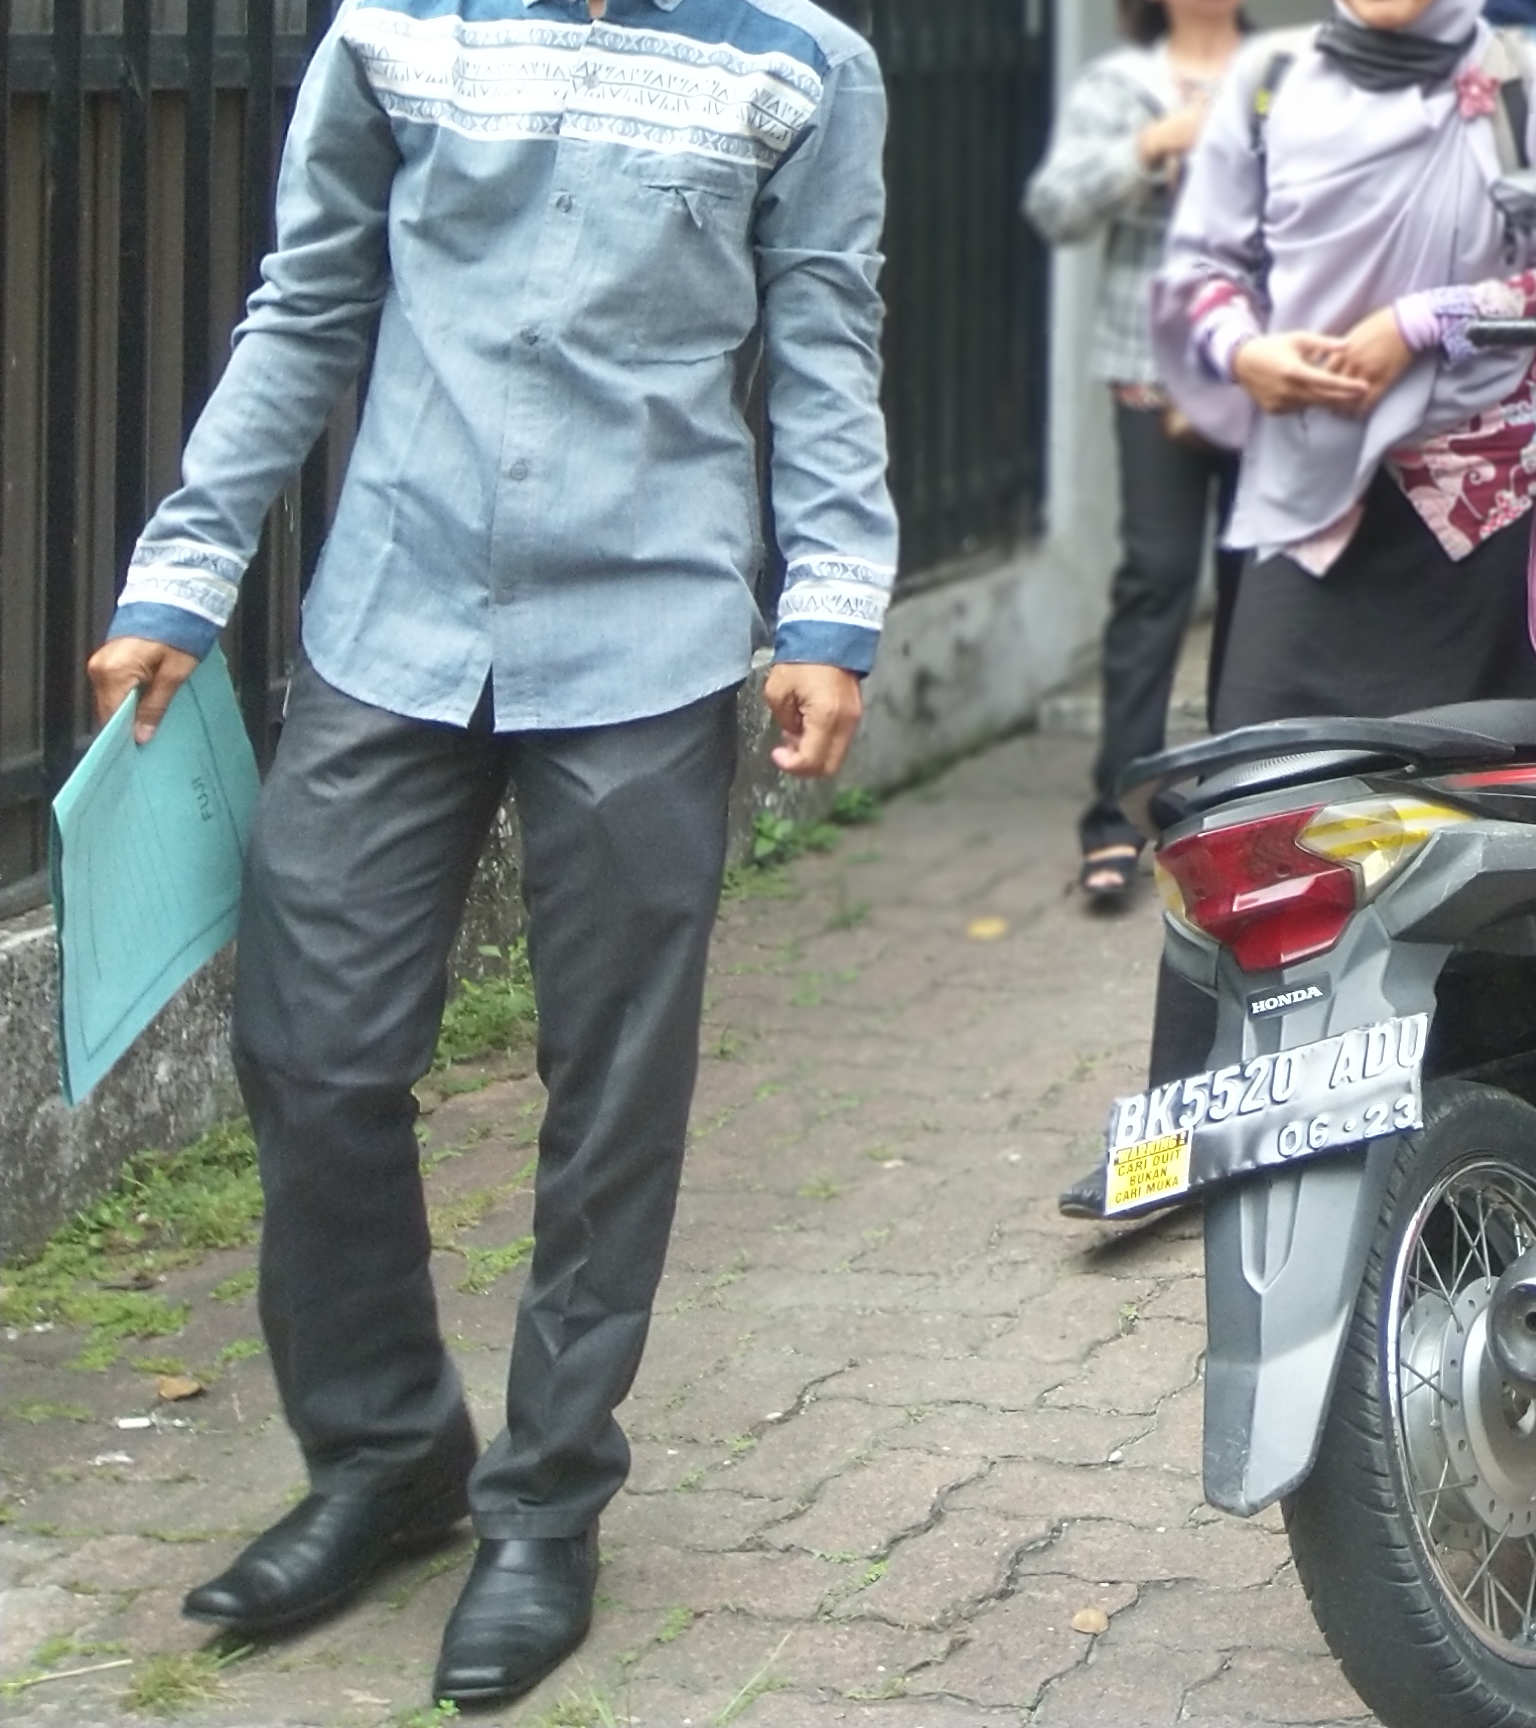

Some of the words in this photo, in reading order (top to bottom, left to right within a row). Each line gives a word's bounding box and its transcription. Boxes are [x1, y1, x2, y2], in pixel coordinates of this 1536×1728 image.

[1251, 985, 1324, 1015] HONDA
[1328, 1014, 1427, 1089] ADU
[1117, 1159, 1148, 1177] CARI
[1152, 1148, 1181, 1168] DUIT
[1129, 1166, 1168, 1187] BUKAN
[1114, 1186, 1142, 1205] CARI
[1145, 1175, 1179, 1195] MUKA
